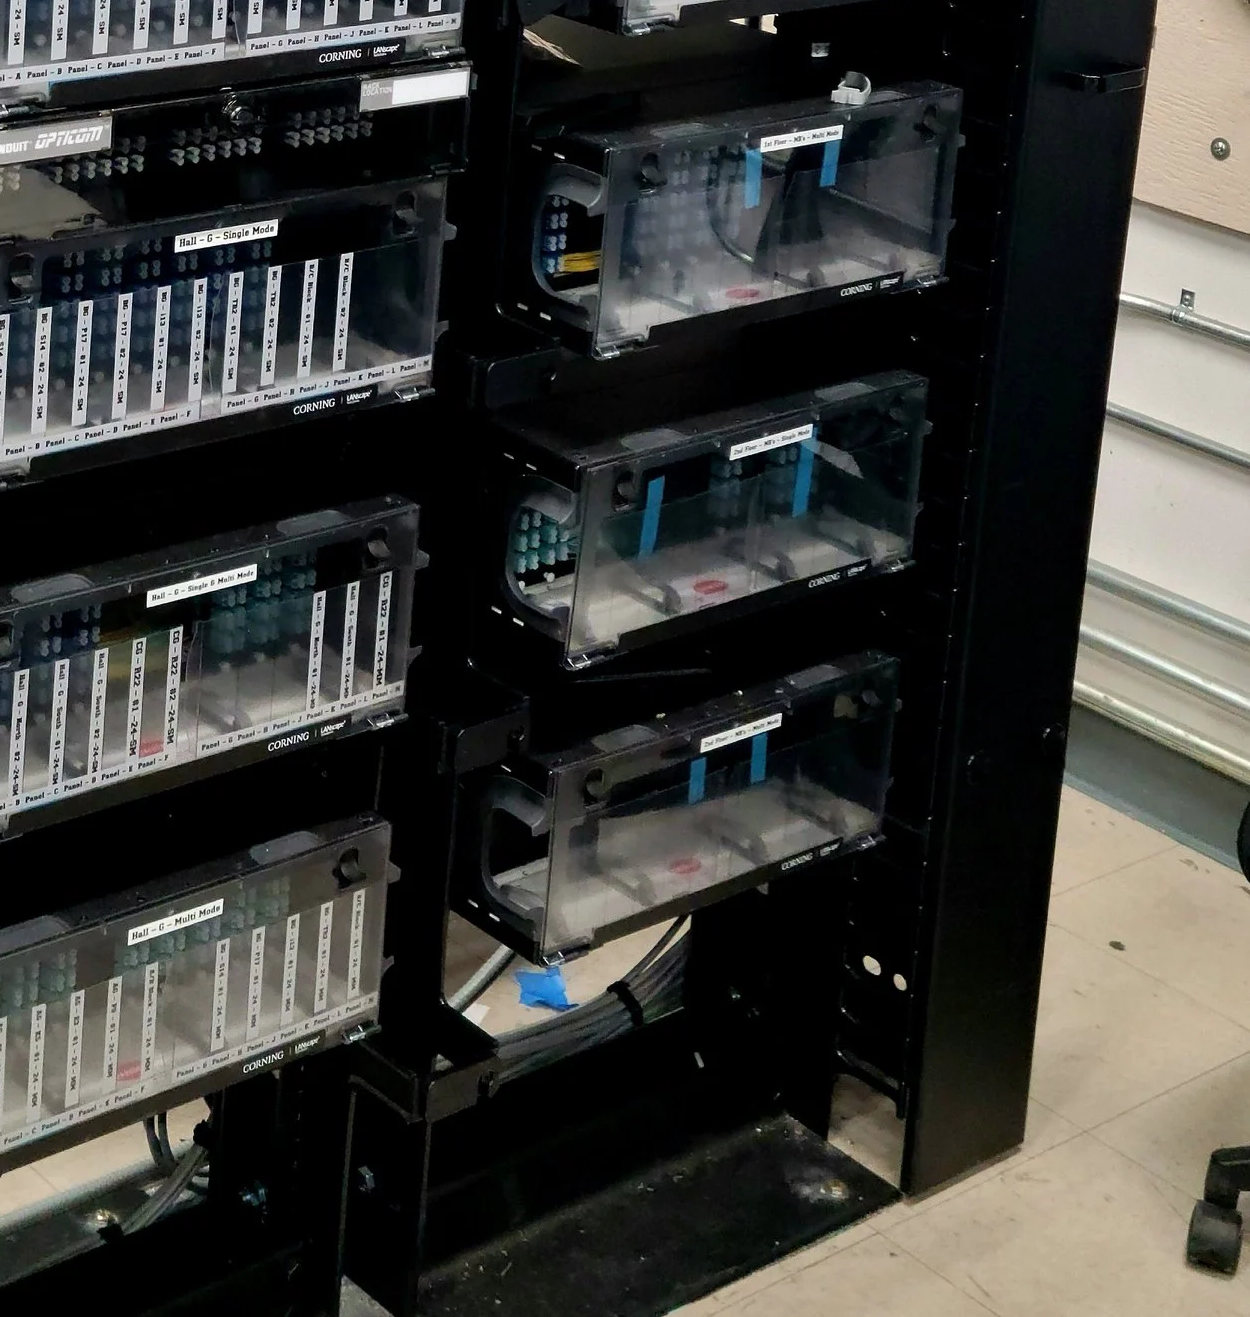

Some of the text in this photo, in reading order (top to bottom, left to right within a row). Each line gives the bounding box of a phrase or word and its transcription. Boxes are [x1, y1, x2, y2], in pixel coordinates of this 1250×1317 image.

[318, 48, 362, 63] CORNING
[178, 223, 274, 247] Hall G Single Mode
[151, 591, 165, 601] Hall
[173, 587, 179, 596] G
[187, 581, 208, 592] Single
[216, 575, 234, 585] Multi
[236, 569, 254, 579] Mode
[131, 904, 220, 940] Hall G Multi Mode
[242, 1049, 284, 1073] CORNING
